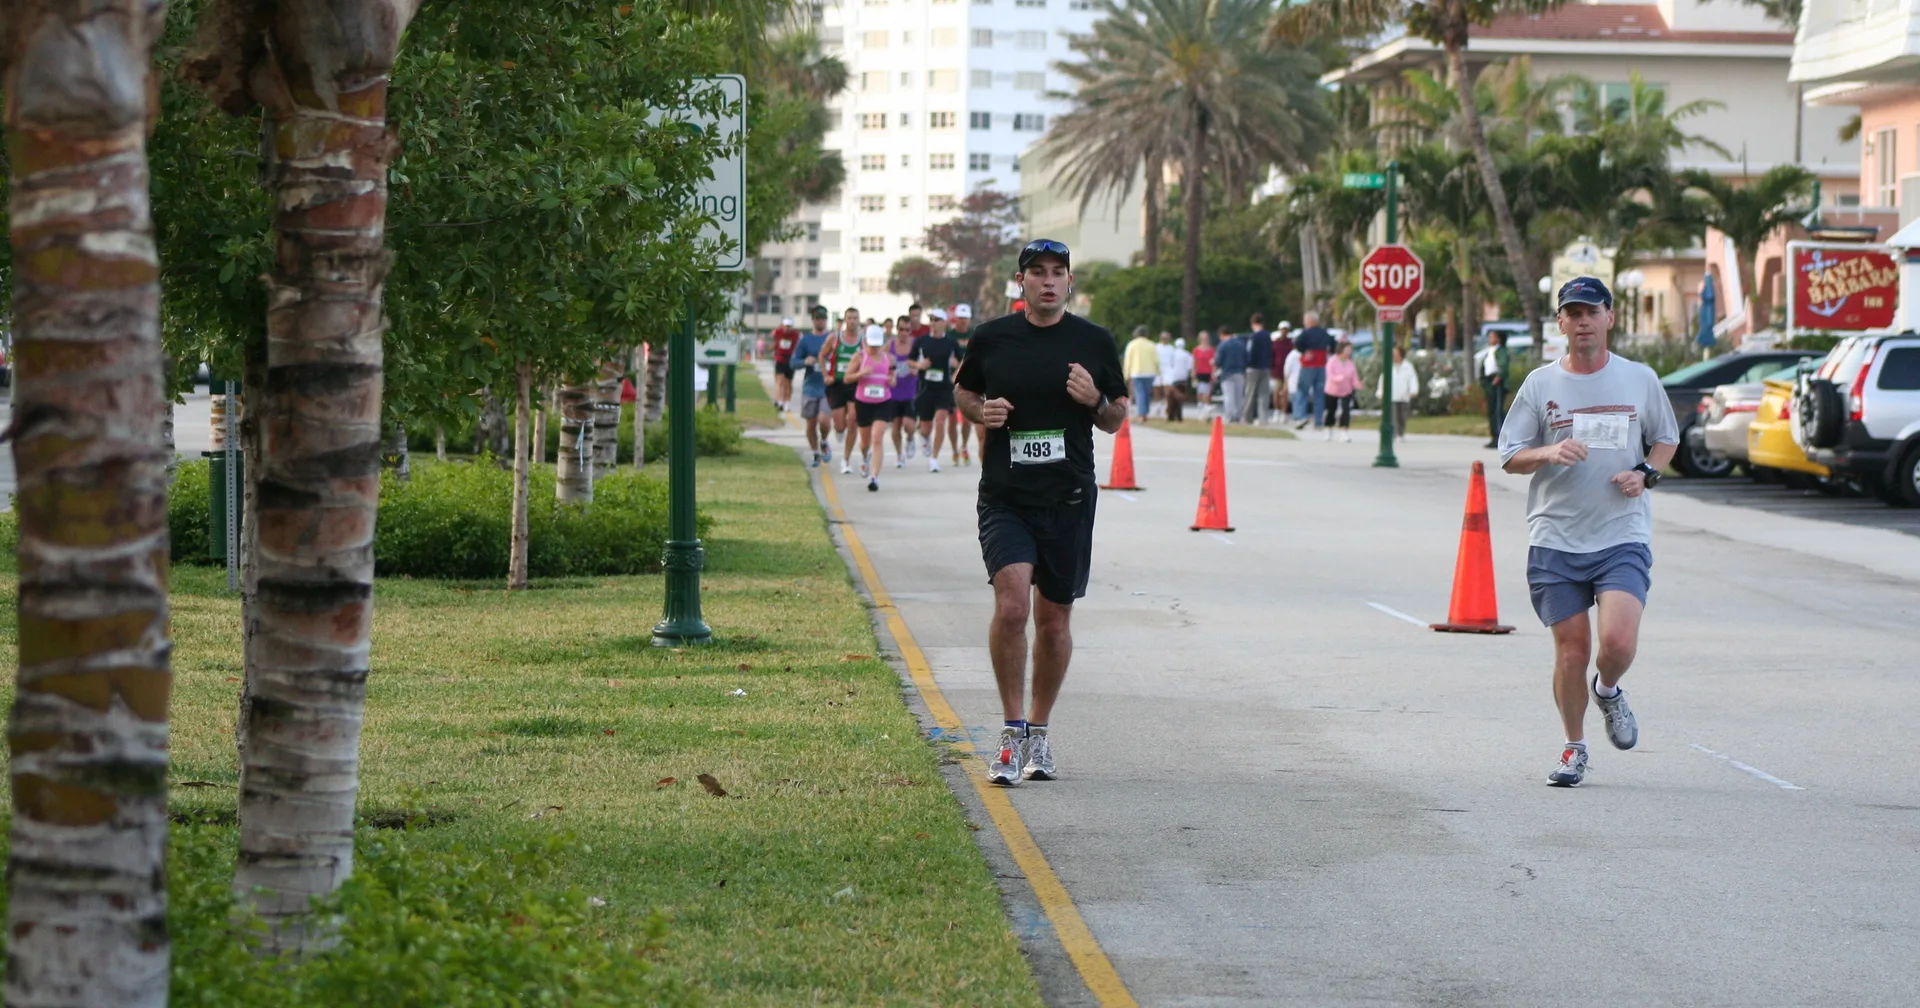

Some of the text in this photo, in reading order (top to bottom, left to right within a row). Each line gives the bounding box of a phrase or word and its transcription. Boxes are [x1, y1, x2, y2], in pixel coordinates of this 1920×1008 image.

[1364, 264, 1419, 289] STOP
[1808, 256, 1874, 287] SANTA
[1808, 267, 1897, 305] BARBARA
[1023, 441, 1052, 458] 493
